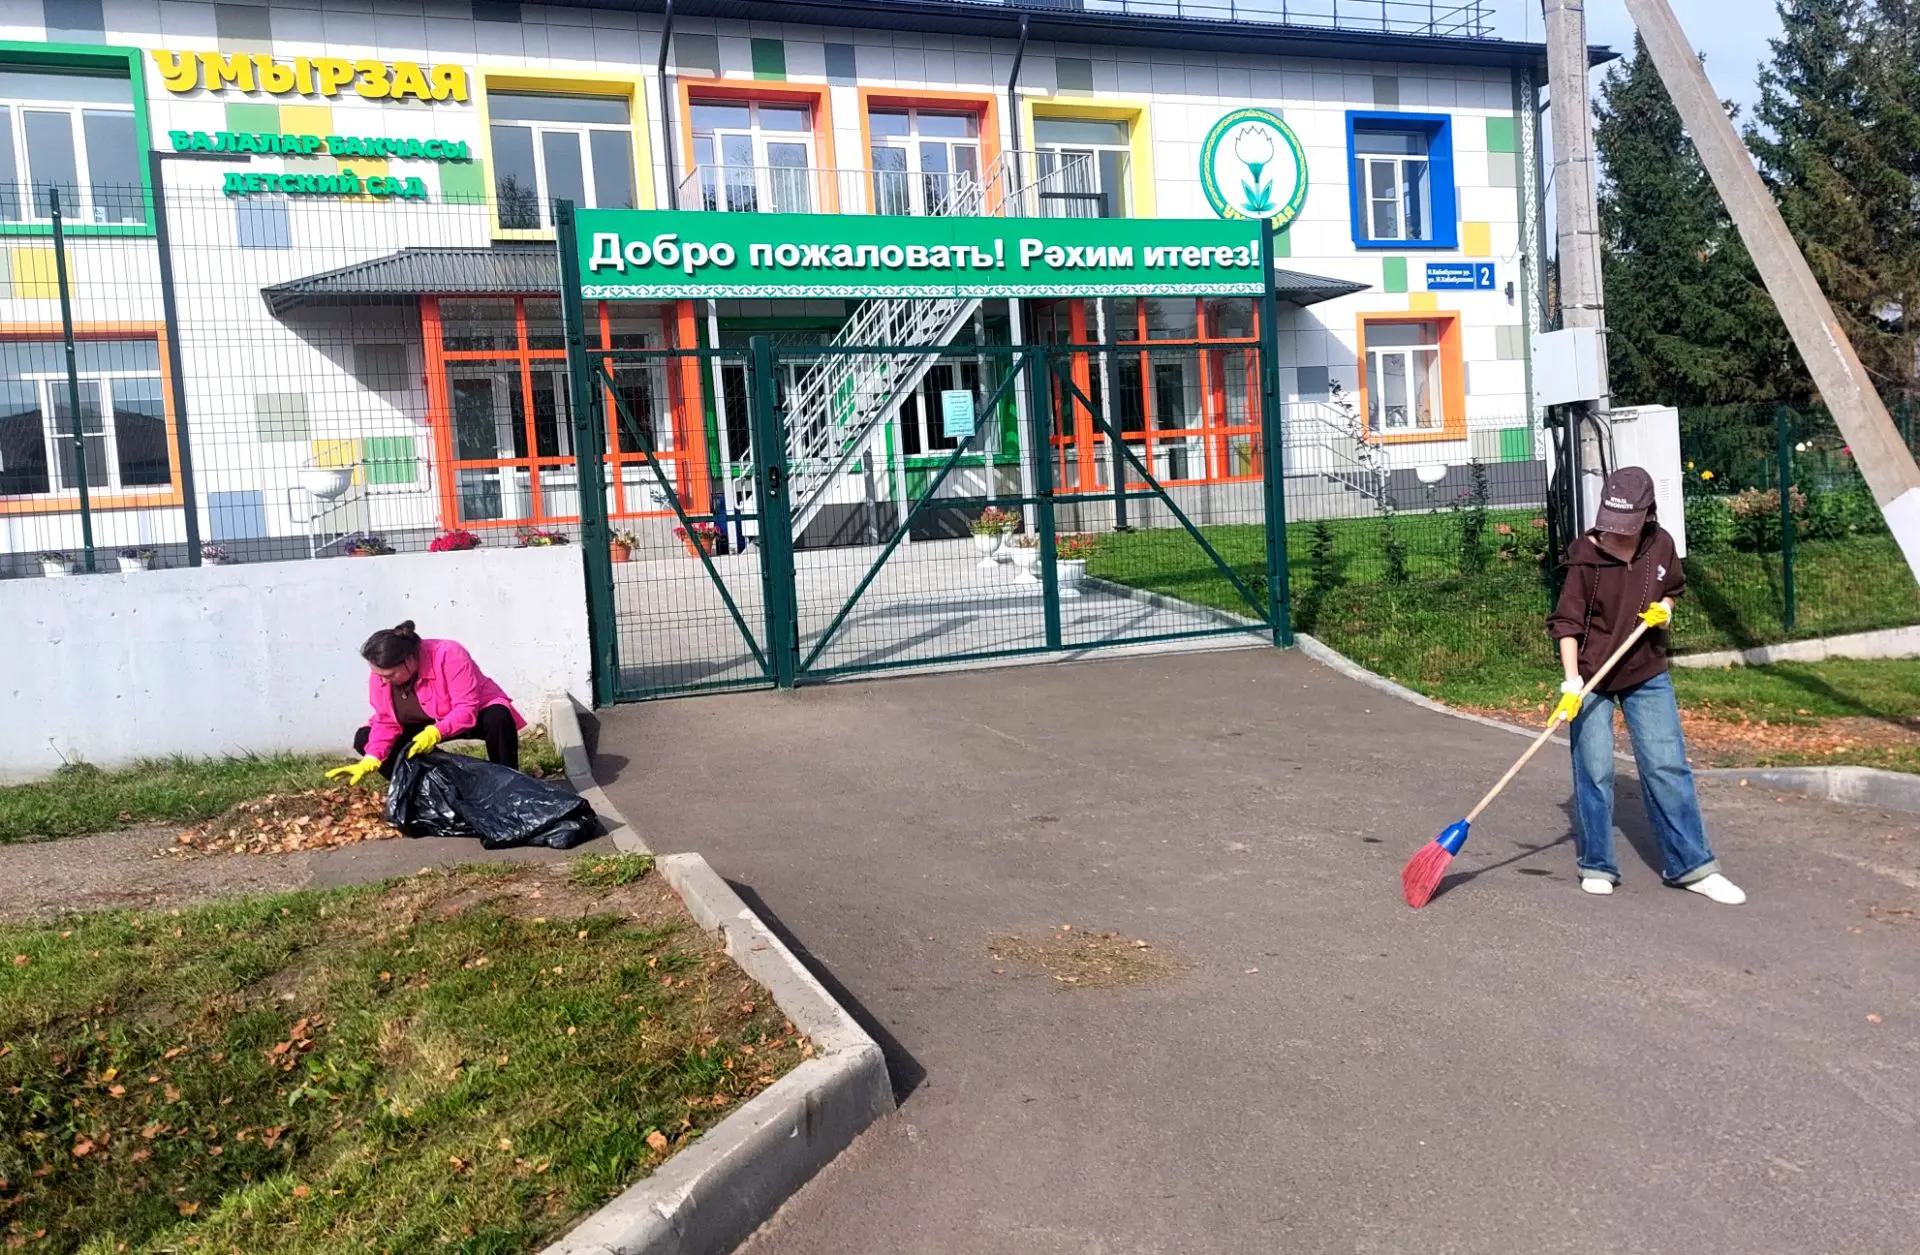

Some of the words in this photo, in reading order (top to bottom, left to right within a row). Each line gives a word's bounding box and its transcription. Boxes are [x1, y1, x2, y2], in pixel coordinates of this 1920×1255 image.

[151, 49, 469, 101] УМЫРЗАЯ
[168, 130, 321, 156] БАЛАЛАР
[325, 136, 468, 159] БАКЧАСЫ
[222, 169, 361, 197] ДЕТСКИЙ
[366, 175, 429, 200] САД
[588, 232, 735, 274] Добро
[749, 238, 1005, 268] пожаловать!
[1019, 238, 1134, 269] Рәхим
[1143, 239, 1261, 267] итегез!
[1481, 267, 1490, 286] 2
